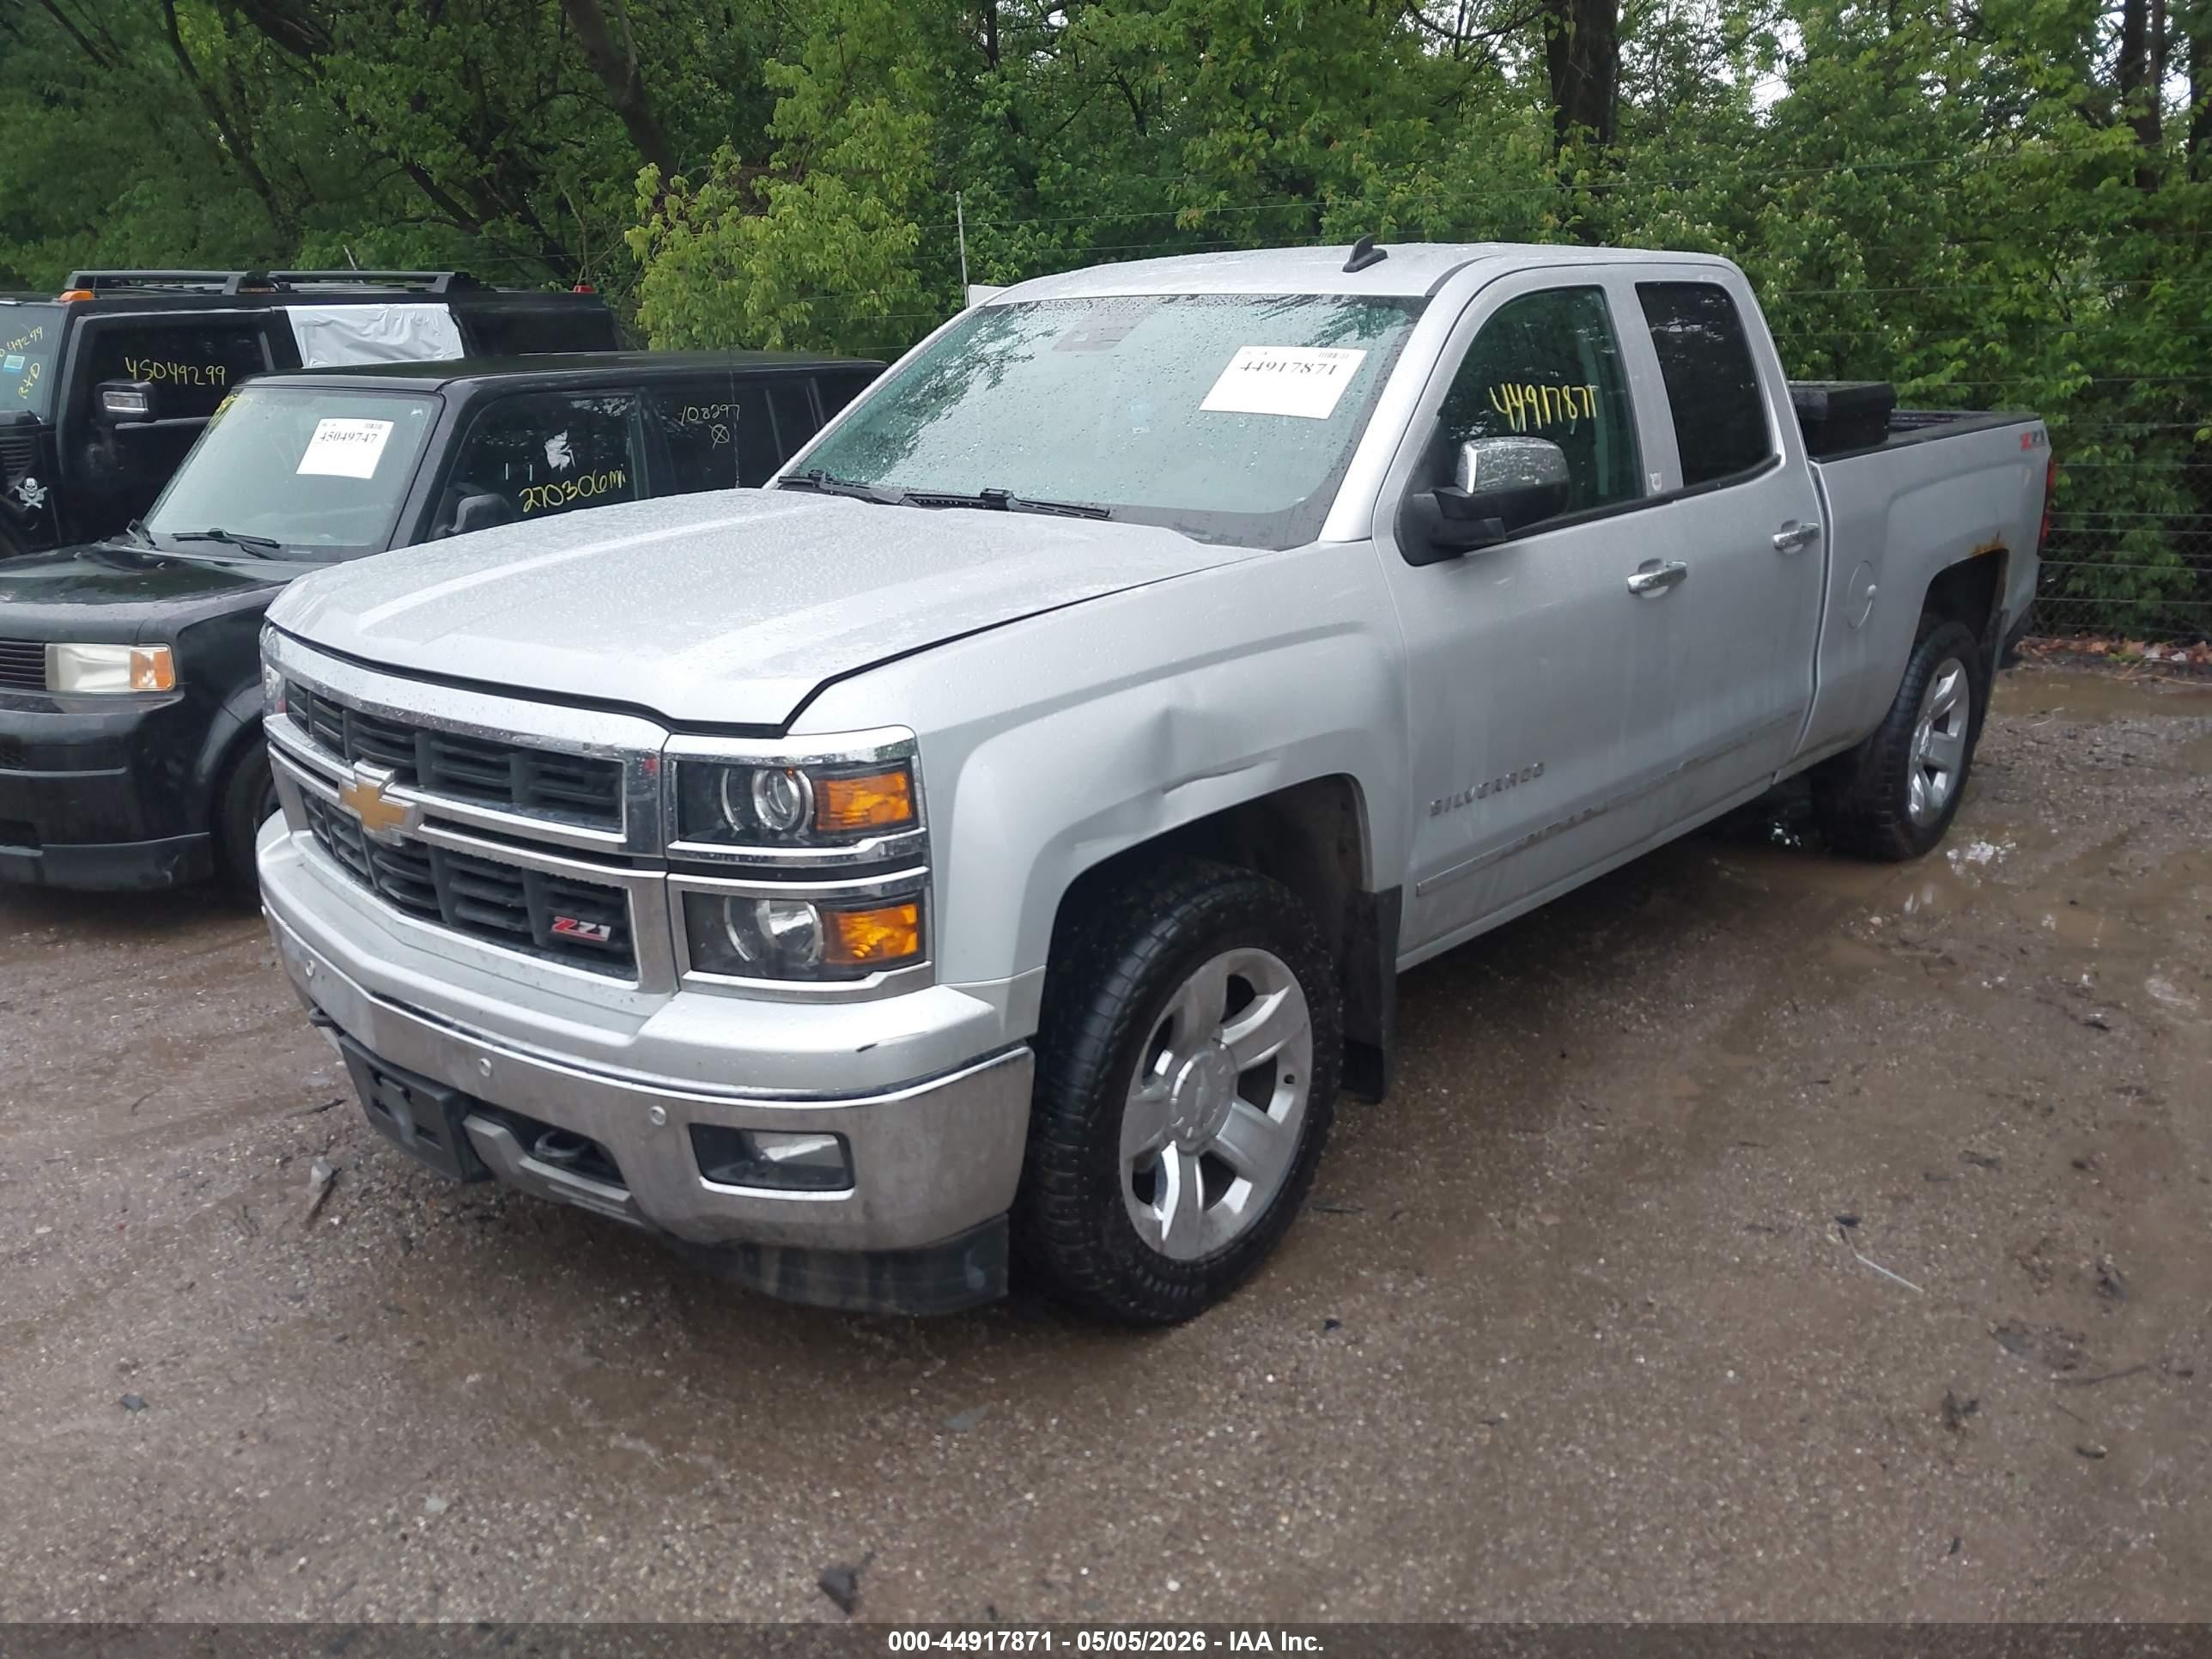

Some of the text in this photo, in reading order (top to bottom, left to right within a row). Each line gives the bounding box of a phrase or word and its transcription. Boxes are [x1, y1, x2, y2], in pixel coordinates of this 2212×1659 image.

[125, 356, 226, 386] 45049299
[1239, 361, 1339, 375] 44917871
[319, 431, 379, 443] 45049747
[552, 915, 612, 942] Z71
